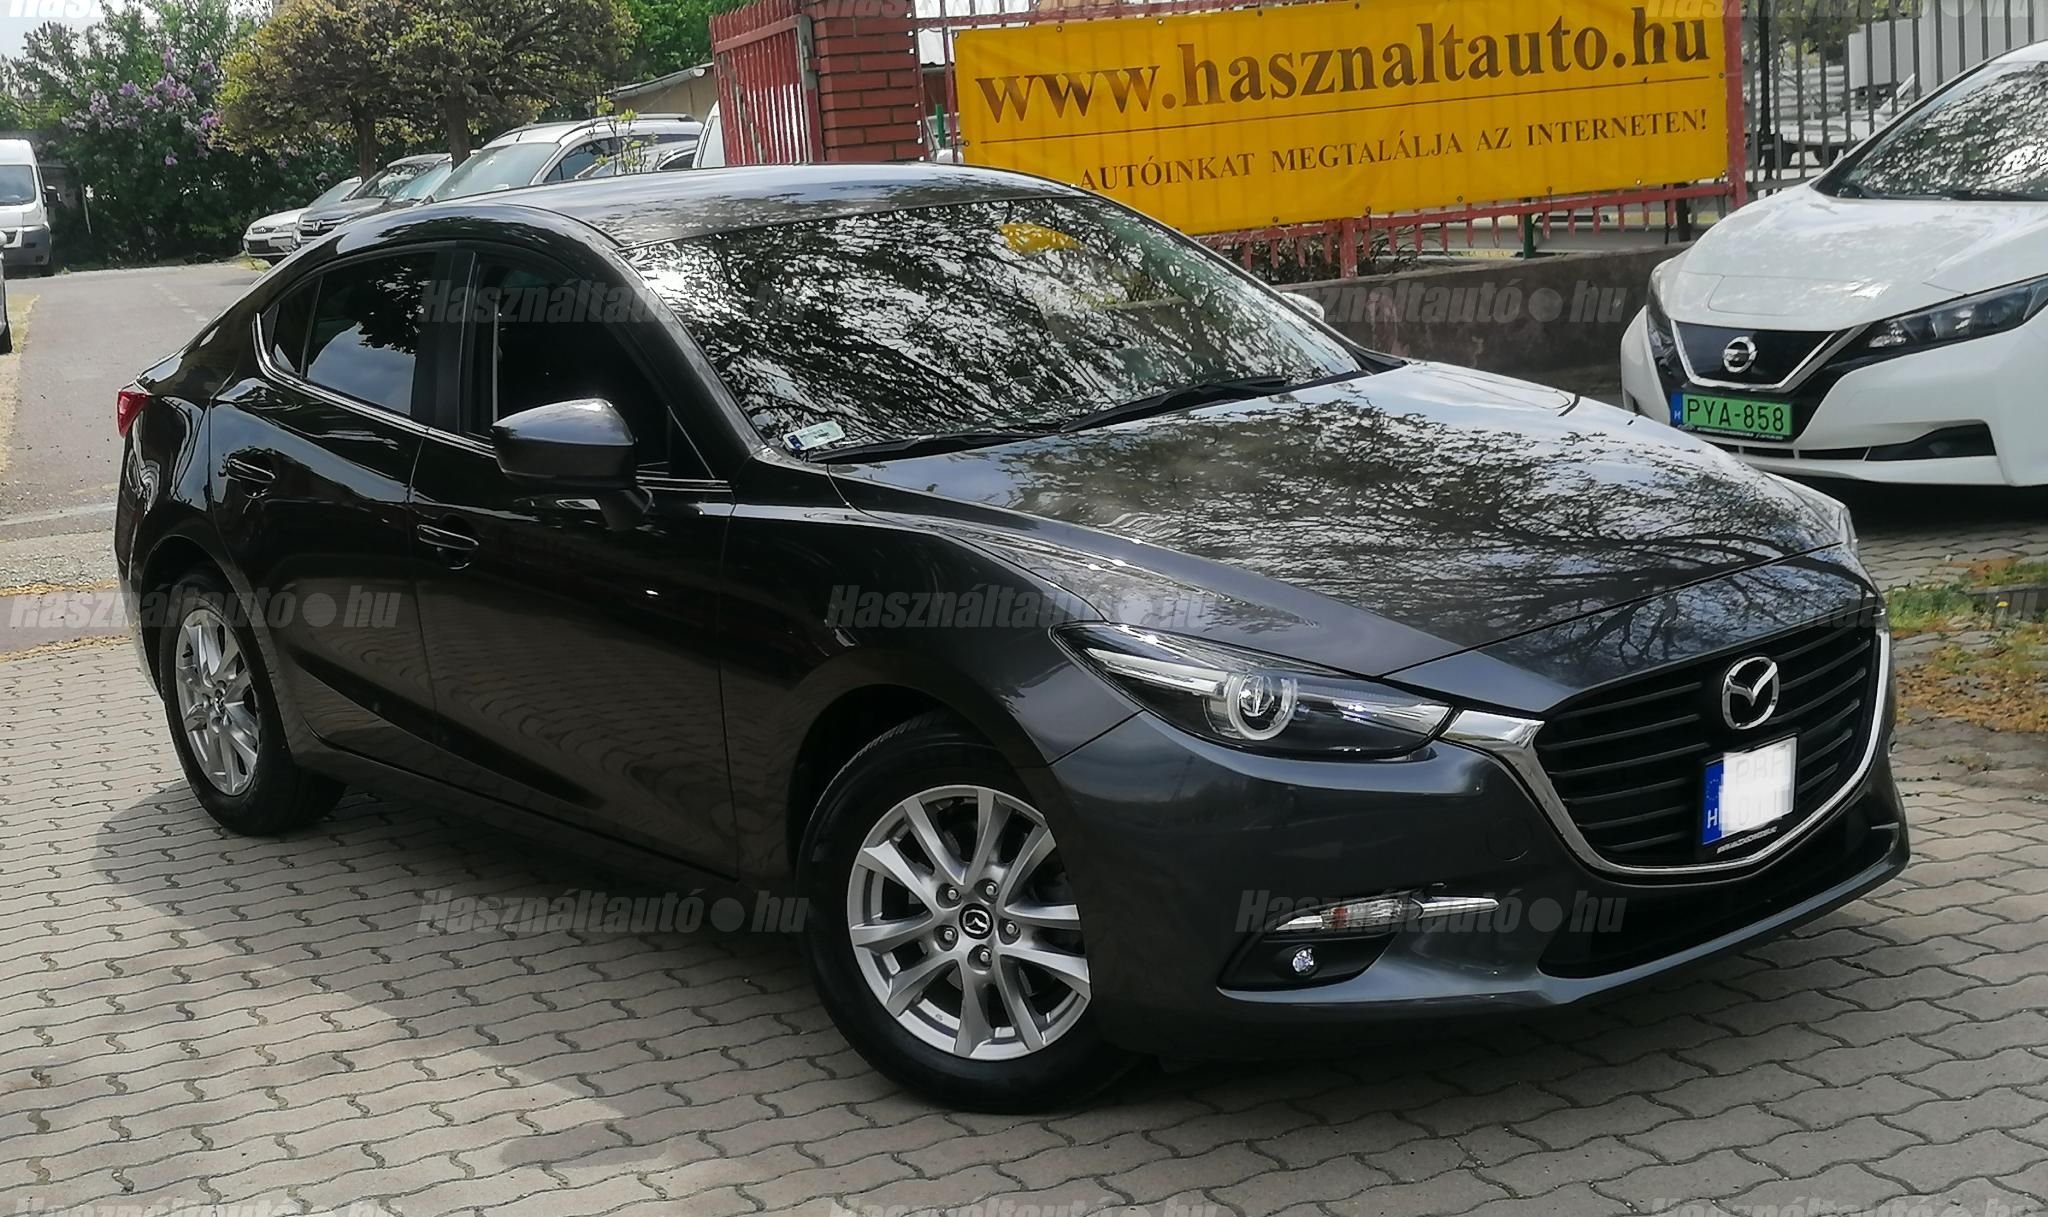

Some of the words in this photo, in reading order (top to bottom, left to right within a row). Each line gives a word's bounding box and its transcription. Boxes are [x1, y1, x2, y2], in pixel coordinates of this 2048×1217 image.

[974, 6, 1711, 124] www.hasznaltauto.hu
[1080, 151, 1256, 191] AUTÓINKAT
[1271, 131, 1464, 173] MEGTALÁLJA
[1476, 127, 1513, 152] AZ
[1526, 108, 1708, 147] INTERNETEN!
[1687, 398, 1785, 432] PYA-858
[1706, 807, 1719, 829] H
